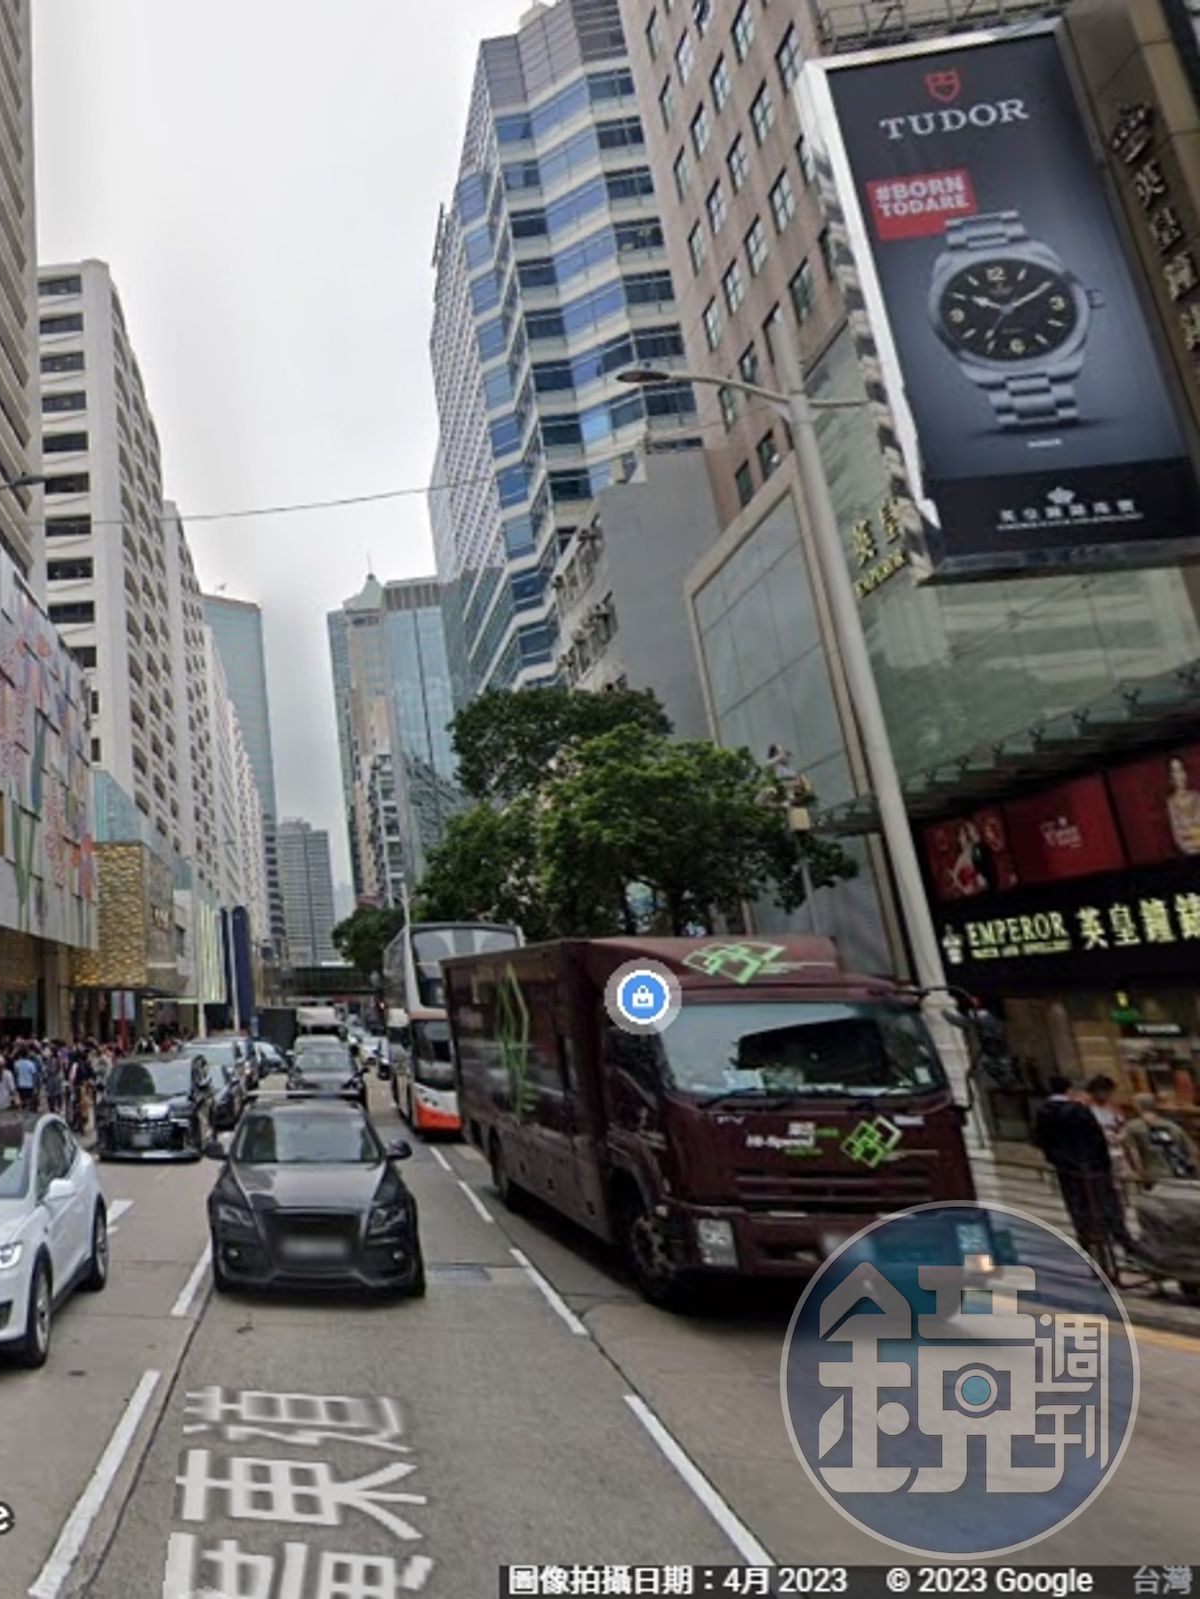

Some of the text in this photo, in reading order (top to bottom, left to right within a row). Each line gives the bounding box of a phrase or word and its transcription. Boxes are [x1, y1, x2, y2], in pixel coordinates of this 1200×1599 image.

[879, 99, 1030, 140] TUDOR
[875, 174, 965, 203] #BORN
[880, 192, 970, 218] TODARE
[965, 911, 1070, 947] EMPEROR
